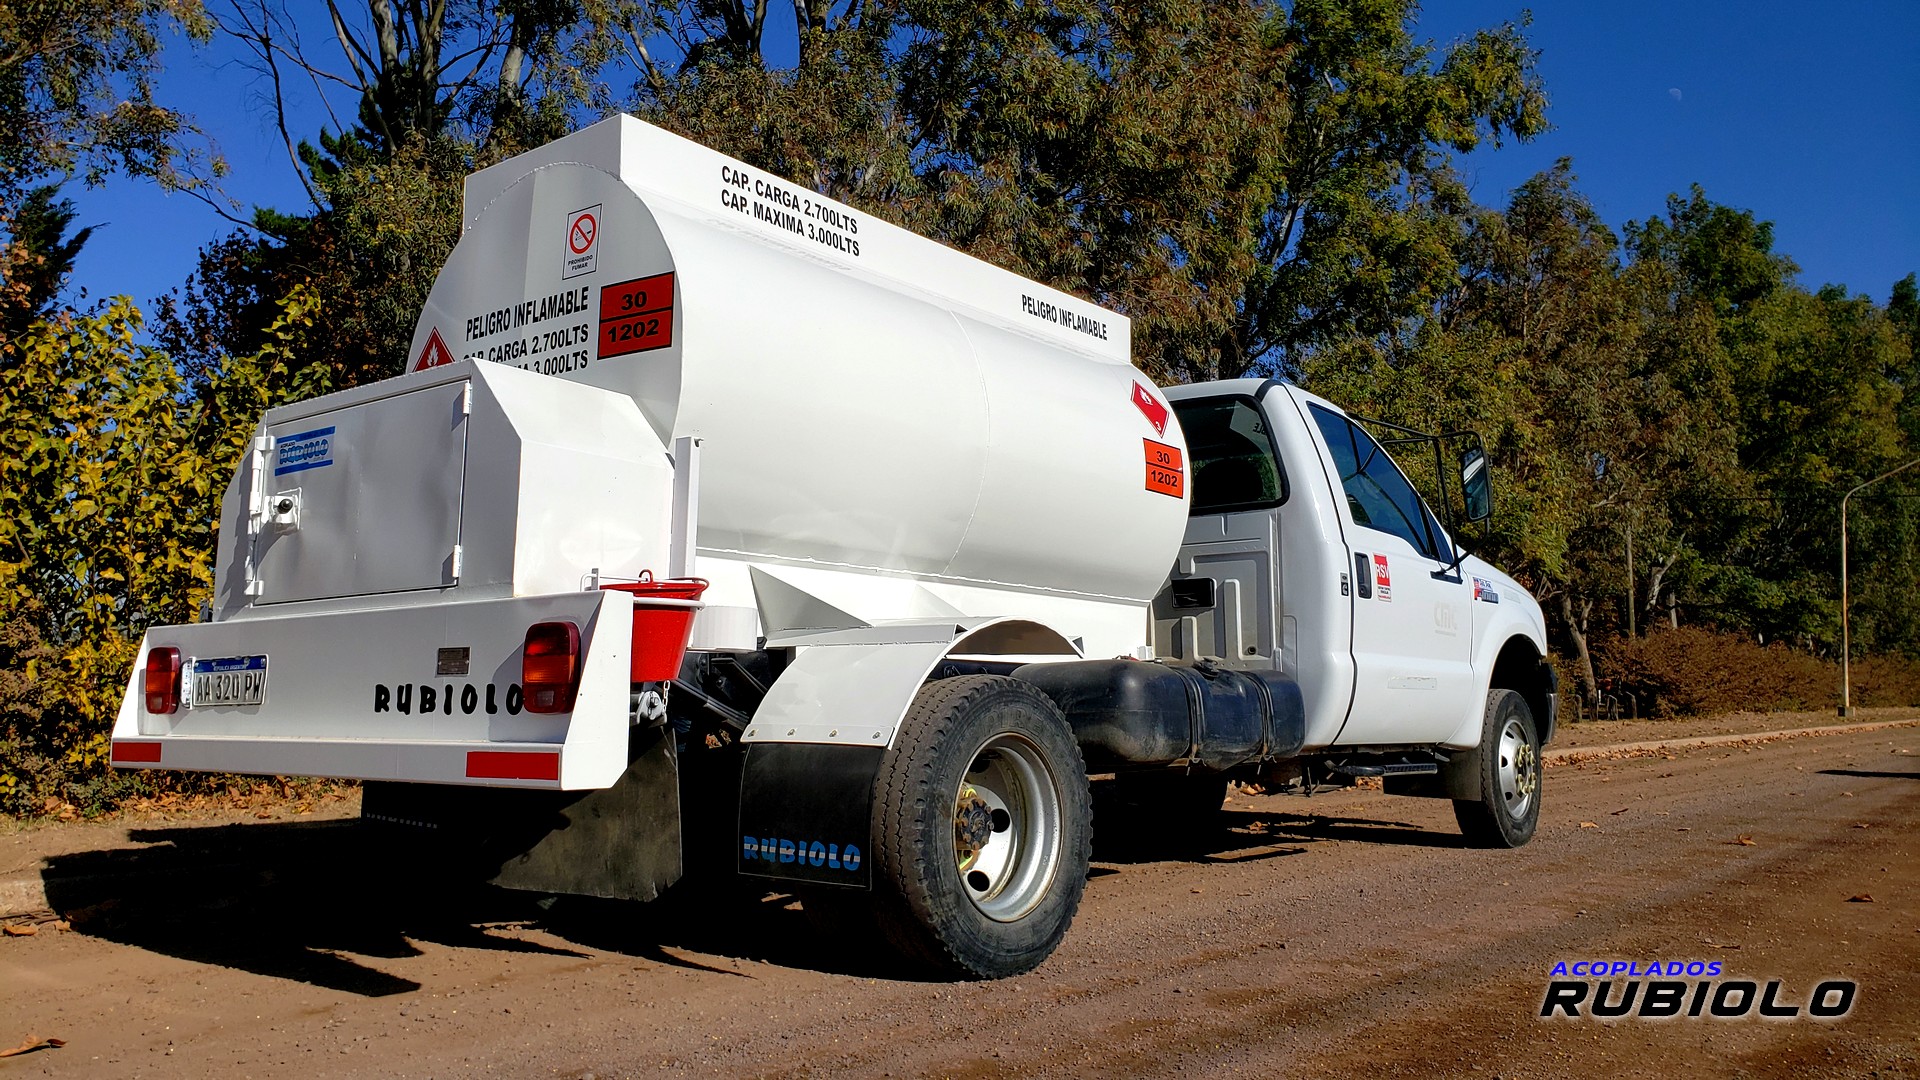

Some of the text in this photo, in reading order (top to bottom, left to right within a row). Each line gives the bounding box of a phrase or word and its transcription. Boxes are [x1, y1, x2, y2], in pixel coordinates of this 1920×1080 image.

[722, 165, 858, 235] CAP. CARGA 2.700LTS
[721, 189, 860, 257] CAP. MAXIMA 3.000LTS
[568, 254, 593, 265] PROHIBIDO
[571, 262, 588, 270] FUMAR
[466, 286, 589, 342] PELIGRO INFLAMABLE
[621, 291, 647, 310] 30
[607, 318, 660, 343] 1202
[1021, 293, 1108, 341] PELIGRO INFLAMABLE
[488, 323, 589, 363] CARGA 2.700LTS
[1155, 421, 1162, 431] 3
[1156, 450, 1170, 465] 30
[1151, 469, 1178, 488] 1202
[196, 674, 213, 702] AA
[215, 672, 241, 701] 320
[374, 683, 524, 716] RUBIOLO
[743, 835, 861, 872] RUBIOLO
